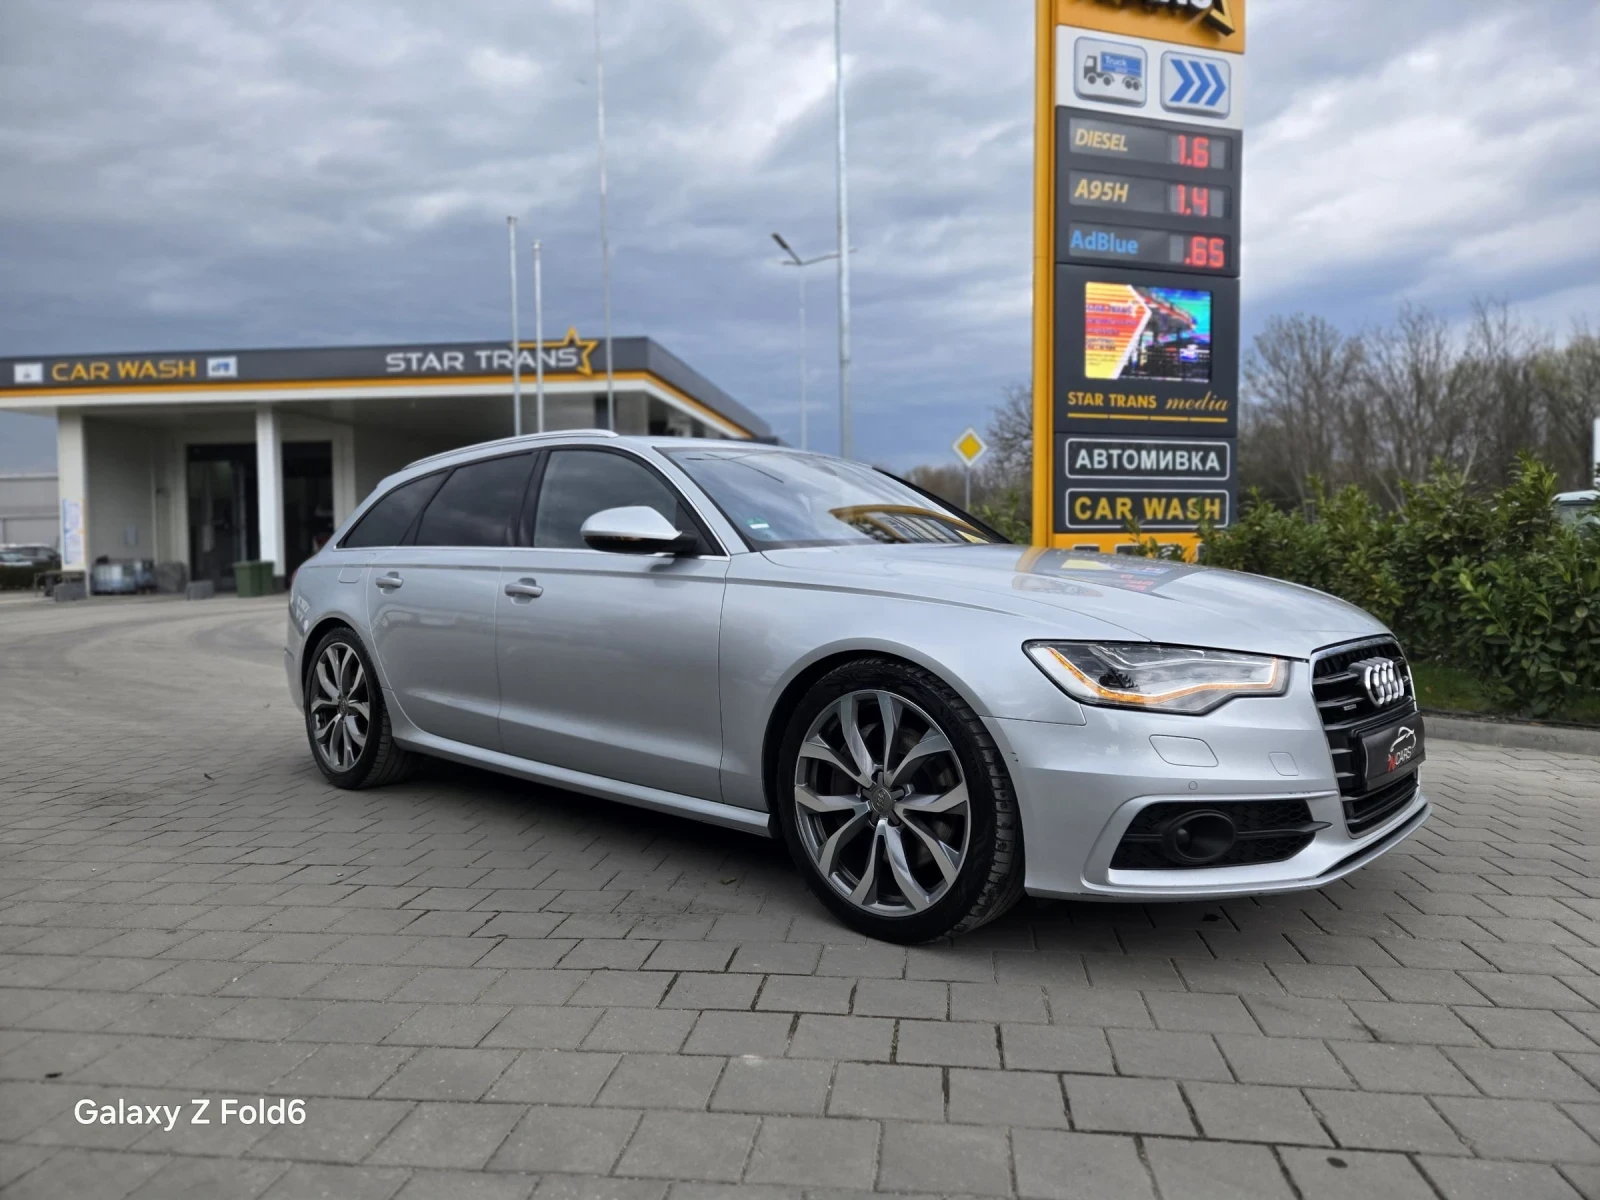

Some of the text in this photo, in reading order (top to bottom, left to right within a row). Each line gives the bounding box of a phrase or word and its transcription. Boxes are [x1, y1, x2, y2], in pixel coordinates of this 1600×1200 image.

[1105, 55, 1127, 66] Truck
[1075, 128, 1129, 152] DIESEL
[1074, 179, 1209, 217] A95H 1.4
[1070, 230, 1139, 255] AdBlue
[52, 360, 197, 381] CAR WASH
[385, 347, 579, 372] STAR TRANS
[1067, 390, 1230, 412] STAR TRANS media
[1075, 448, 1221, 472] АВТОМИВКА
[1074, 497, 1221, 521] CAR WASH
